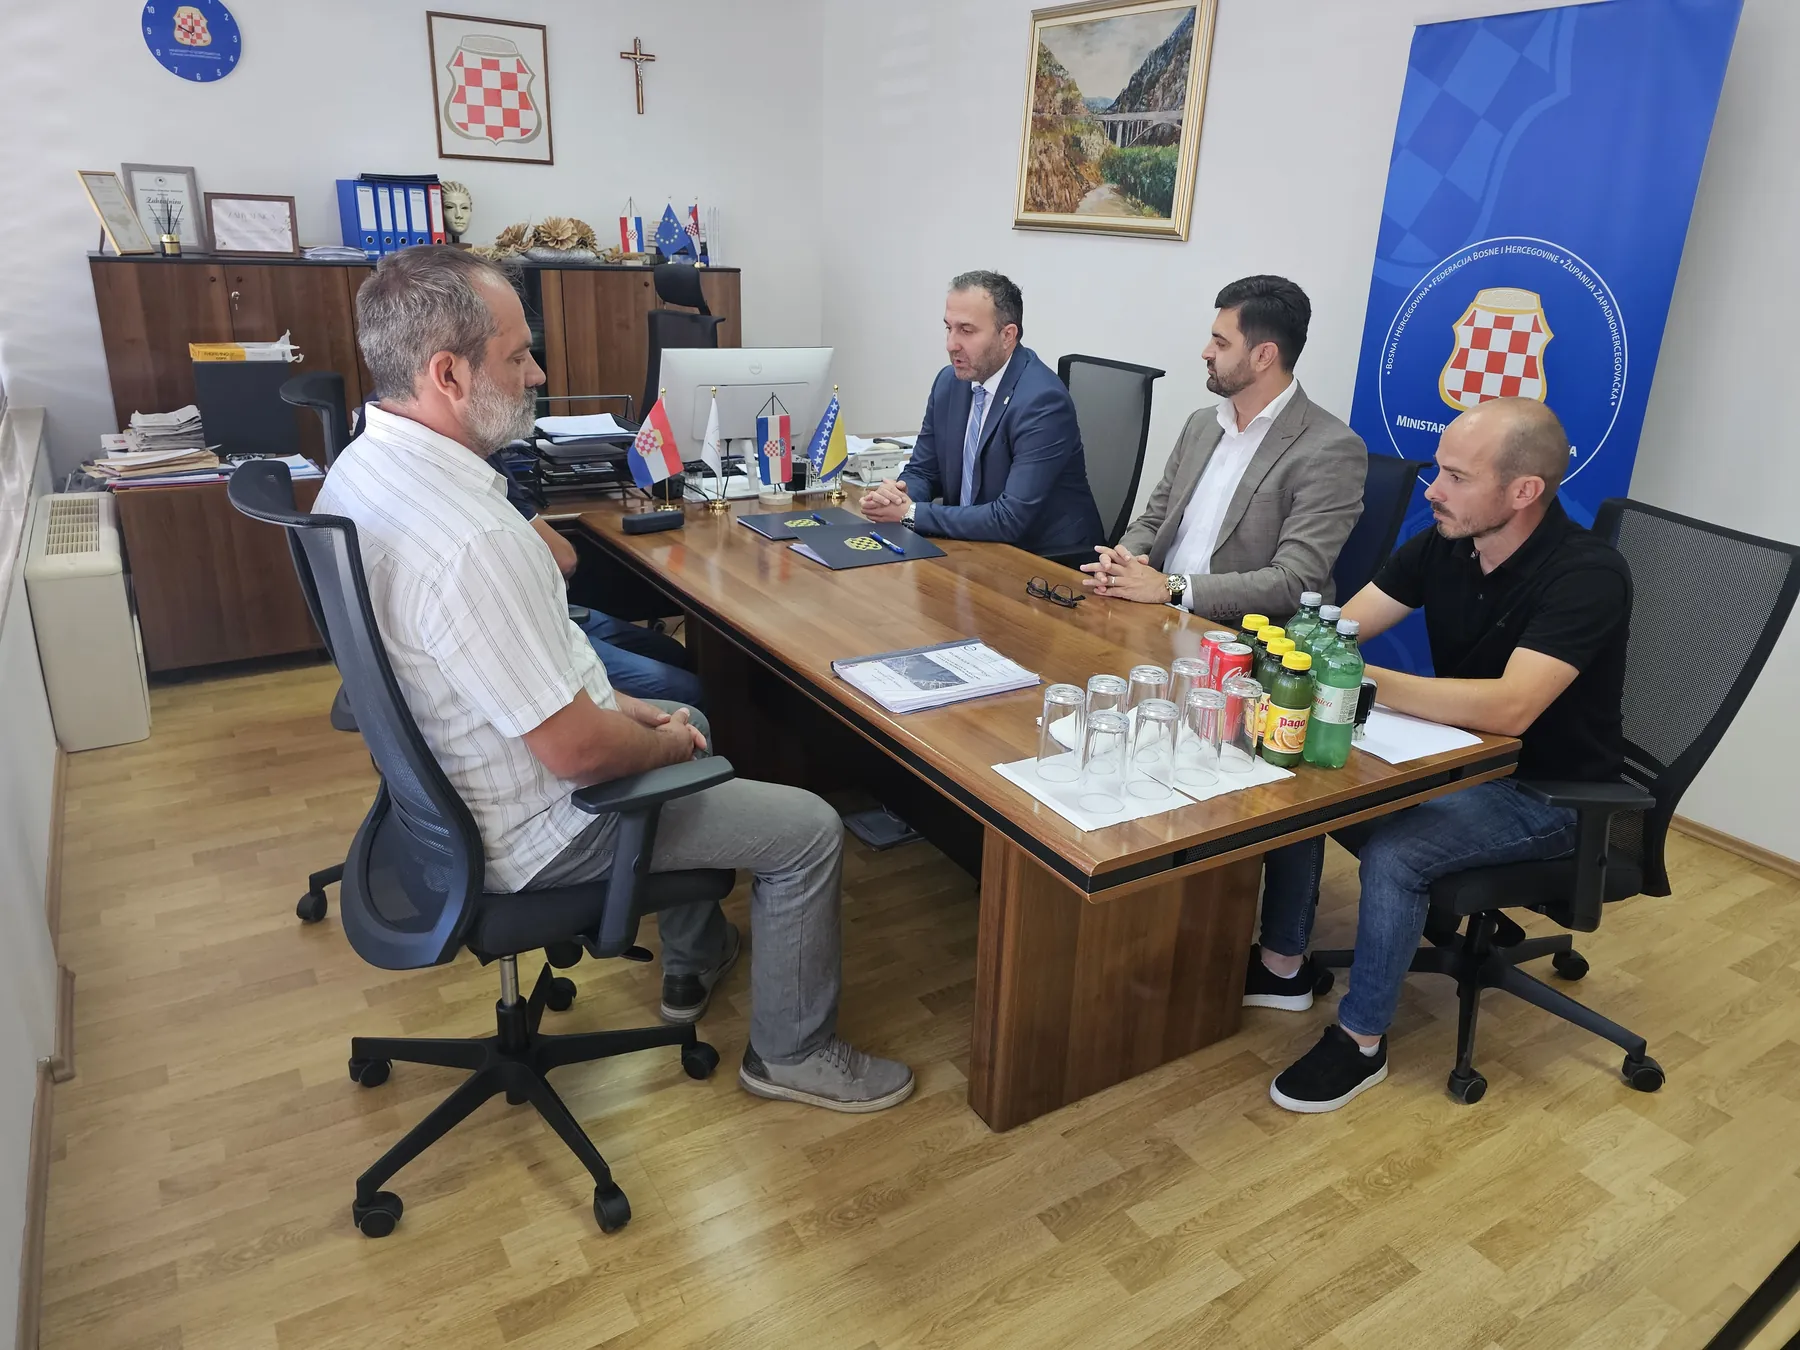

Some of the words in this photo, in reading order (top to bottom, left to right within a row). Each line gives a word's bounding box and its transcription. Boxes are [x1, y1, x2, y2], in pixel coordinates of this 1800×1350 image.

[146, 6, 155, 14] 10
[224, 13, 229, 21] 2
[146, 27, 152, 35] 9
[232, 35, 238, 43] 3
[156, 48, 161, 56] 8
[174, 66, 178, 74] 7
[216, 68, 222, 76] 5
[1431, 255, 1473, 286] FEDERACIJA
[1472, 246, 1500, 261] BOSNE
[1505, 245, 1560, 264] HERCEGOVINE
[1385, 342, 1398, 370] BOSNA
[1394, 286, 1430, 338] HERCEGOVINA
[1562, 258, 1596, 293] ŽUPANIJA
[1592, 288, 1622, 400] ZAPADNOHERCEGOVAČKA
[1396, 414, 1447, 434] MINISTAR
